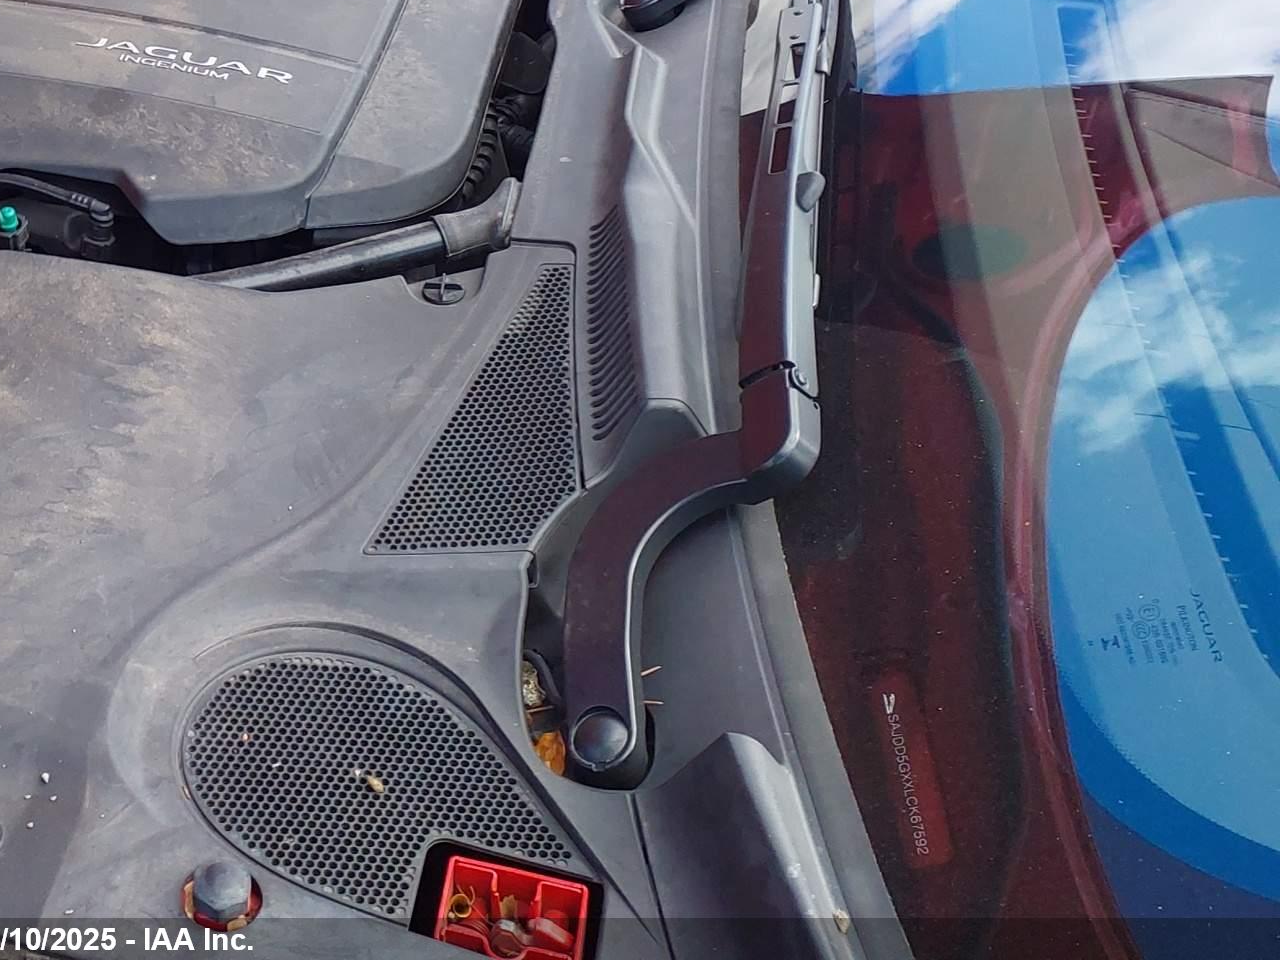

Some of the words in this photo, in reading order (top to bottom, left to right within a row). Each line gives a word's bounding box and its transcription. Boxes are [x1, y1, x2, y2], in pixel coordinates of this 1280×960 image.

[74, 37, 295, 85] JAGUAR
[119, 53, 231, 80] INGENIUM
[1188, 588, 1224, 663] JAGUAR
[887, 713, 930, 856] SAJDD5GXXLCK67592
